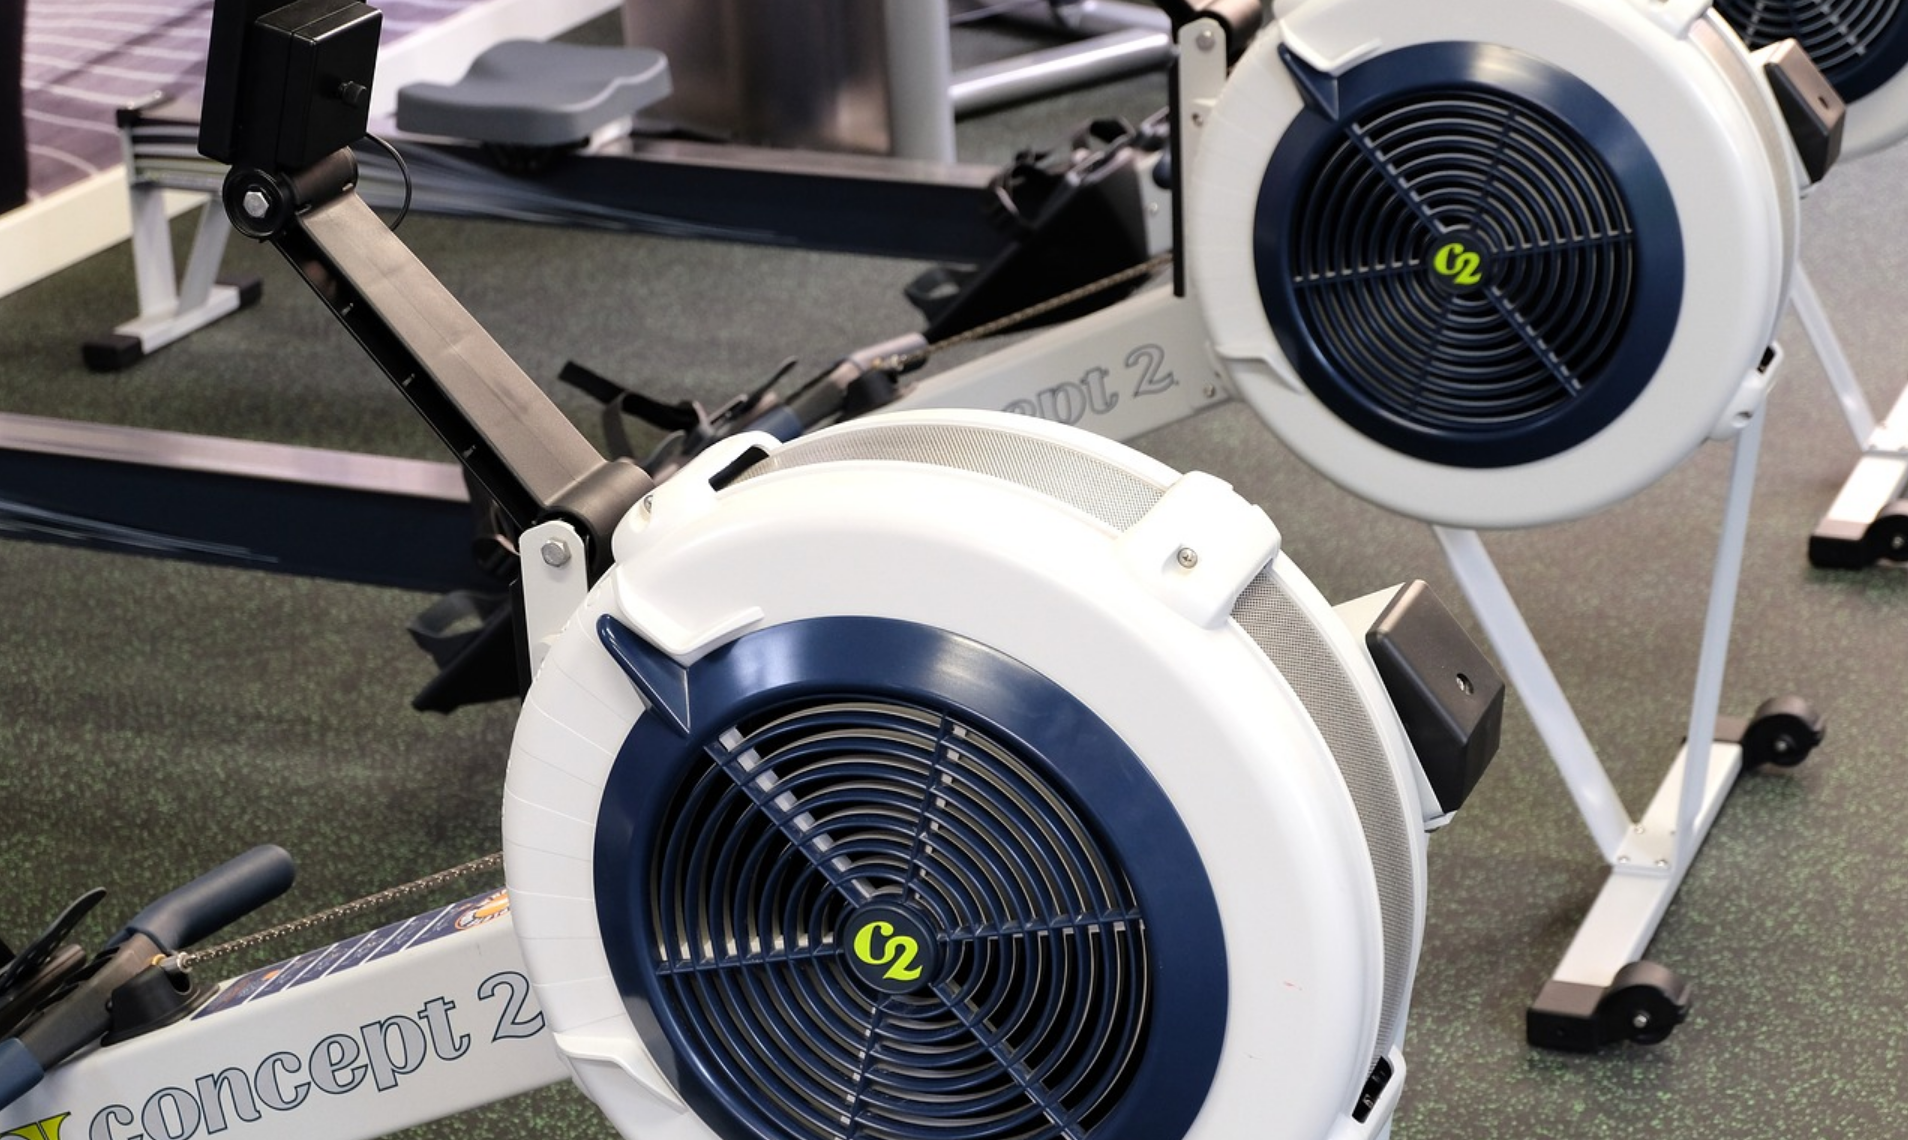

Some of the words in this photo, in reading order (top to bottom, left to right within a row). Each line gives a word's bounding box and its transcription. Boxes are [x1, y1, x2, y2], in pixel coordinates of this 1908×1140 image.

[1433, 242, 1482, 285] C2
[1124, 343, 1175, 397] 2
[853, 921, 923, 981] C2
[88, 996, 471, 1140] concept
[477, 971, 545, 1044] 2
